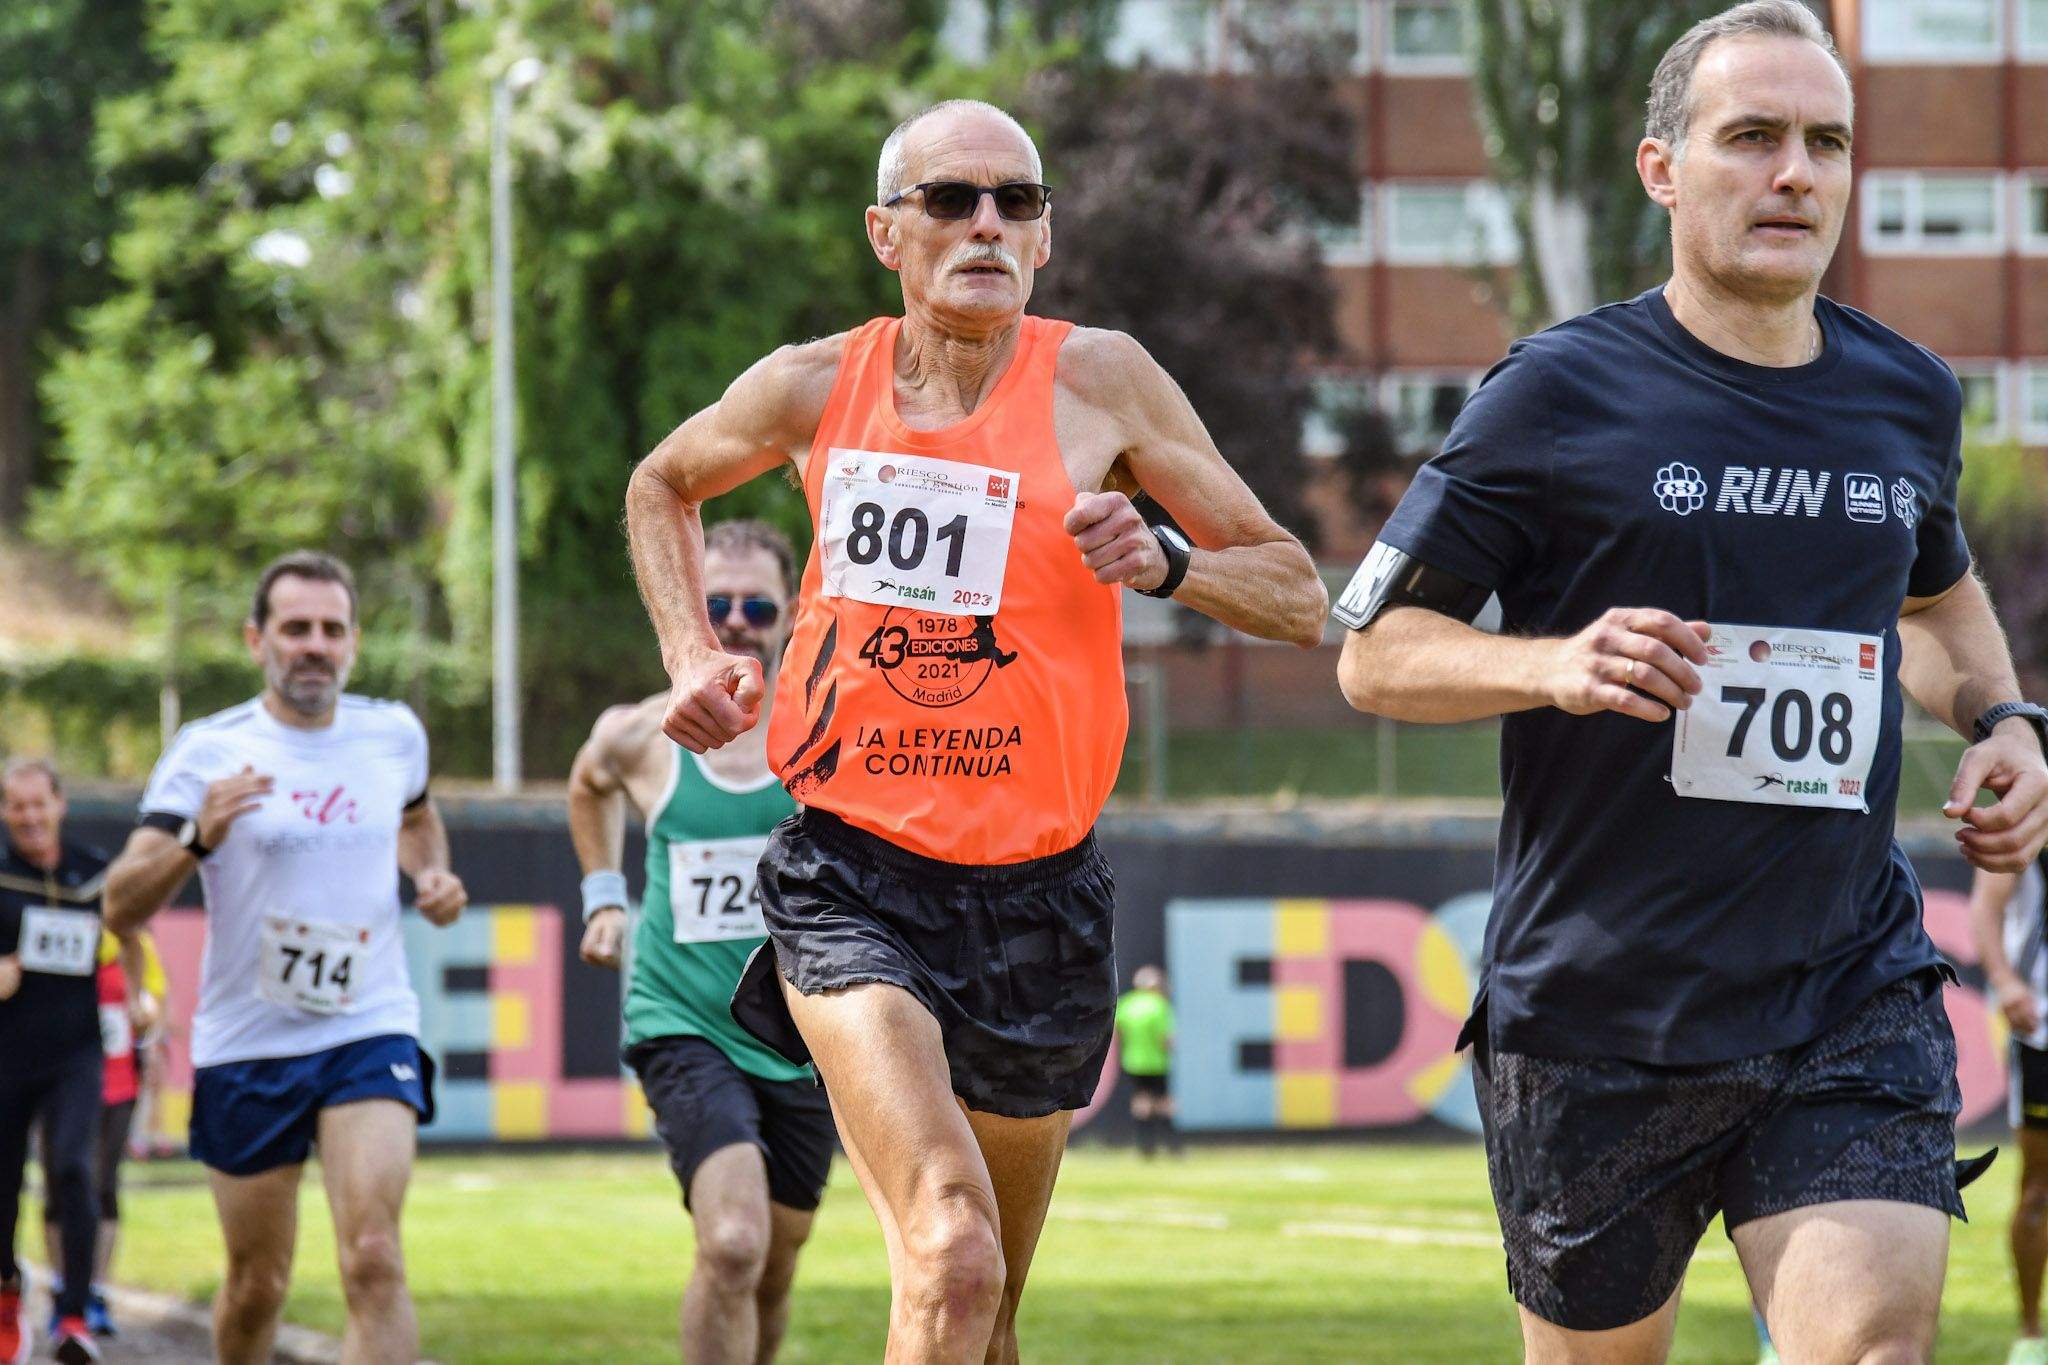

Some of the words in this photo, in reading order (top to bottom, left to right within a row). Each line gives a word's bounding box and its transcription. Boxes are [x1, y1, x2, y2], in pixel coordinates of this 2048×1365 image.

[897, 467, 948, 480] RIESGO
[933, 480, 978, 492] gestión
[1715, 466, 1831, 518] RUN
[1849, 480, 1881, 502] UA
[1850, 500, 1881, 509] RUNNING
[846, 502, 968, 578] 801
[898, 585, 936, 602] rasán
[953, 589, 993, 608] 2023
[917, 618, 958, 633] 1978
[858, 626, 909, 669] 43
[911, 638, 979, 655] EDICIONES
[1772, 643, 1826, 655] RIESGO
[918, 663, 959, 679] 2021
[912, 686, 962, 703] Madrid
[1721, 685, 1852, 765] 708
[856, 726, 886, 748] LA
[899, 725, 1022, 750] LEYENDA
[865, 749, 1012, 777] CONTINÚA
[1786, 777, 1828, 795] rasán
[1838, 778, 1862, 796] 2023
[281, 945, 353, 992] 714
